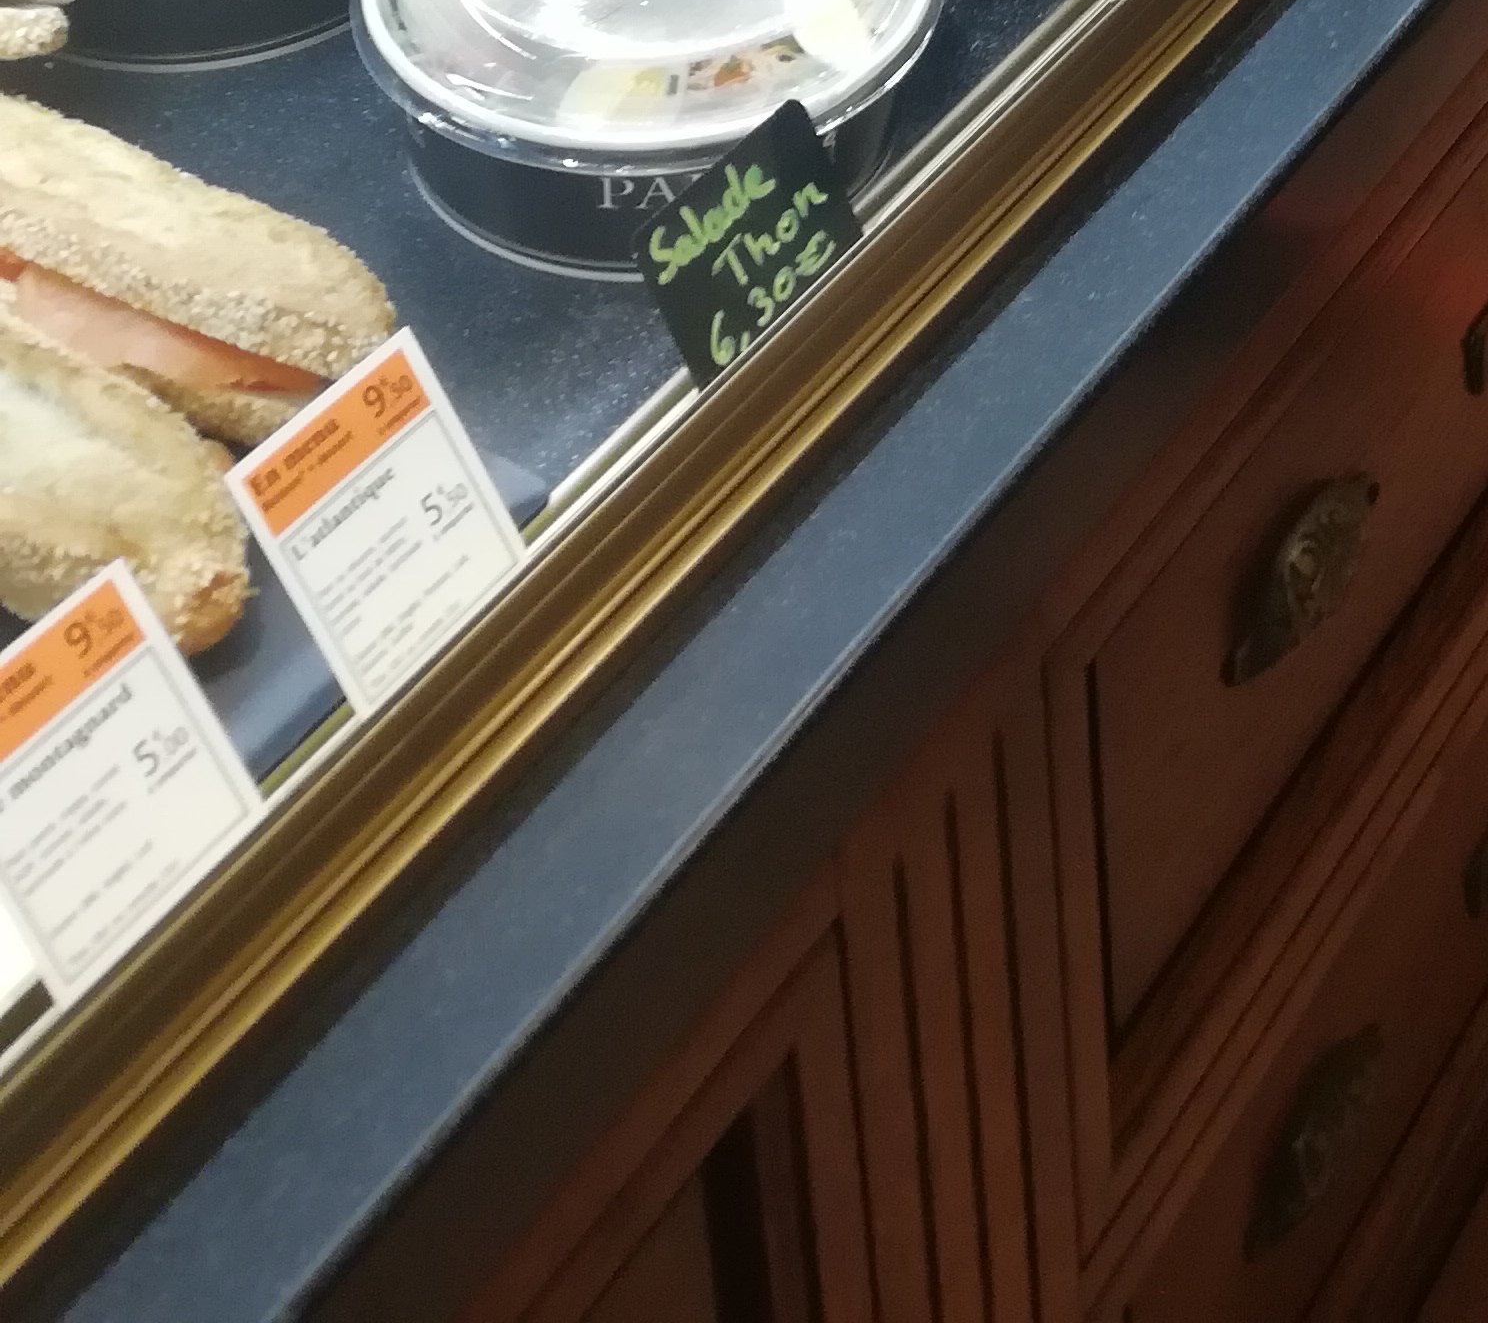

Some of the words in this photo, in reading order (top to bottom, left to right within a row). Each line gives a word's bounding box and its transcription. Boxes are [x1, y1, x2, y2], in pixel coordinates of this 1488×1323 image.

[597, 173, 705, 209] PA
[649, 163, 776, 286] Salade
[711, 181, 829, 286] Thon
[710, 229, 837, 367] 6,30€
[250, 468, 281, 497] En
[283, 418, 340, 471] menu
[291, 467, 395, 561] L'atlantique
[9, 683, 132, 800] montagnard
